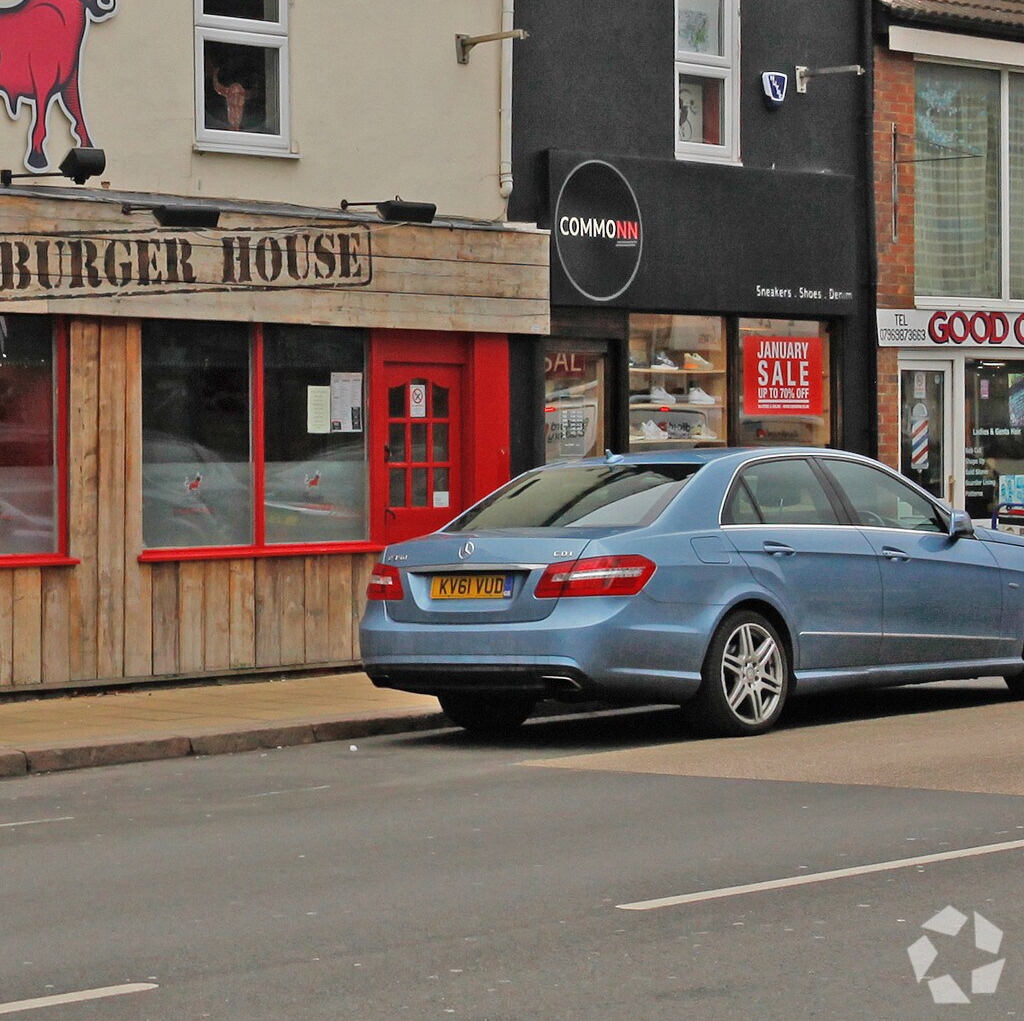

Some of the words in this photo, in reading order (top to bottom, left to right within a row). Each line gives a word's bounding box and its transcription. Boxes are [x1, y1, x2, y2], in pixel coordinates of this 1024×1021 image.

[559, 216, 638, 239] COMMONN
[220, 233, 363, 284] HOUSE
[756, 285, 792, 298] Sneakers
[799, 287, 822, 300] Shoes
[894, 314, 908, 326] TEL
[928, 311, 1010, 344] GOOD
[757, 341, 809, 360] JANUARY
[544, 352, 587, 372] SAL
[757, 360, 810, 387] SALE
[758, 388, 768, 399] UP
[769, 388, 779, 399] TO
[780, 388, 794, 399] 70%
[796, 388, 810, 399] OFF
[972, 427, 989, 436] Ladies
[995, 427, 1010, 436] Gents
[439, 578, 472, 595] KV61
[476, 577, 504, 594] VUD
